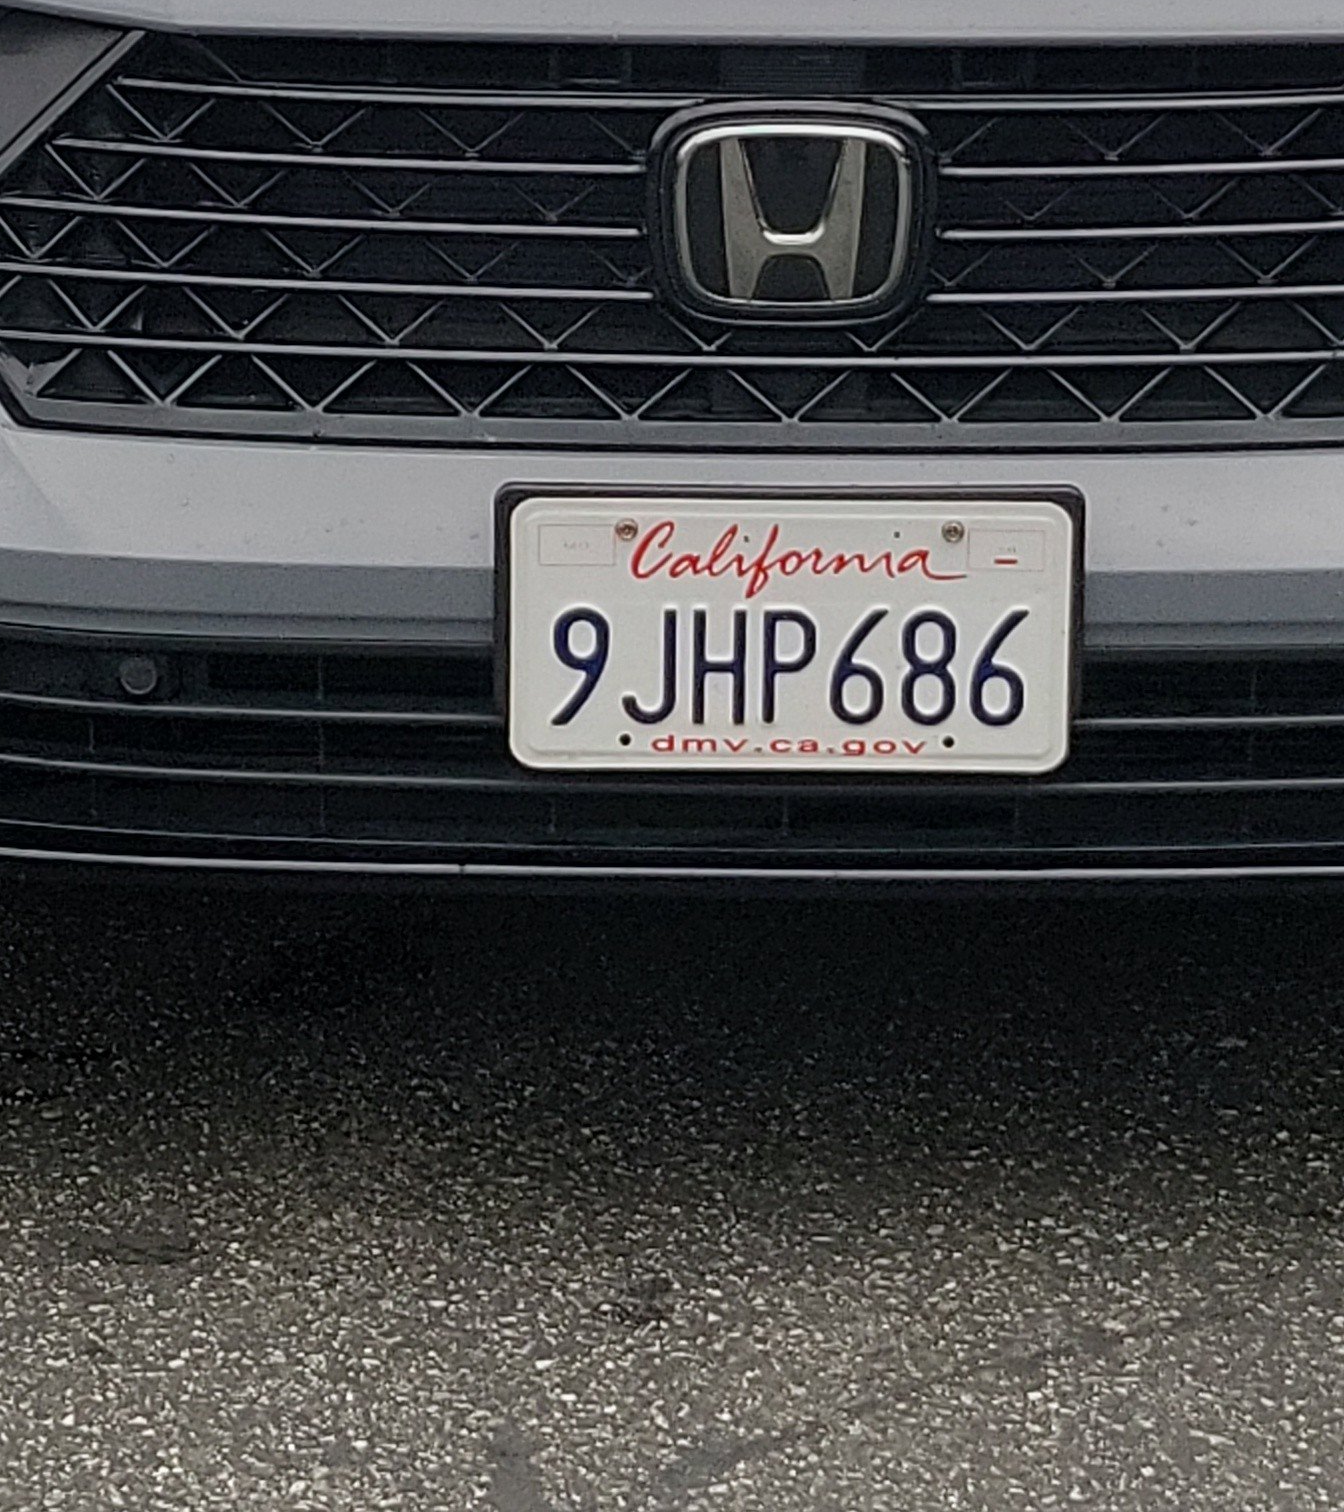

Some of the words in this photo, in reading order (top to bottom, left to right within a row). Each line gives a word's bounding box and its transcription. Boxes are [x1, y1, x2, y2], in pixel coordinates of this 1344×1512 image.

[629, 519, 968, 600] California
[550, 604, 1031, 728] 9JHP686
[650, 733, 928, 759] dmv.ca.gov
